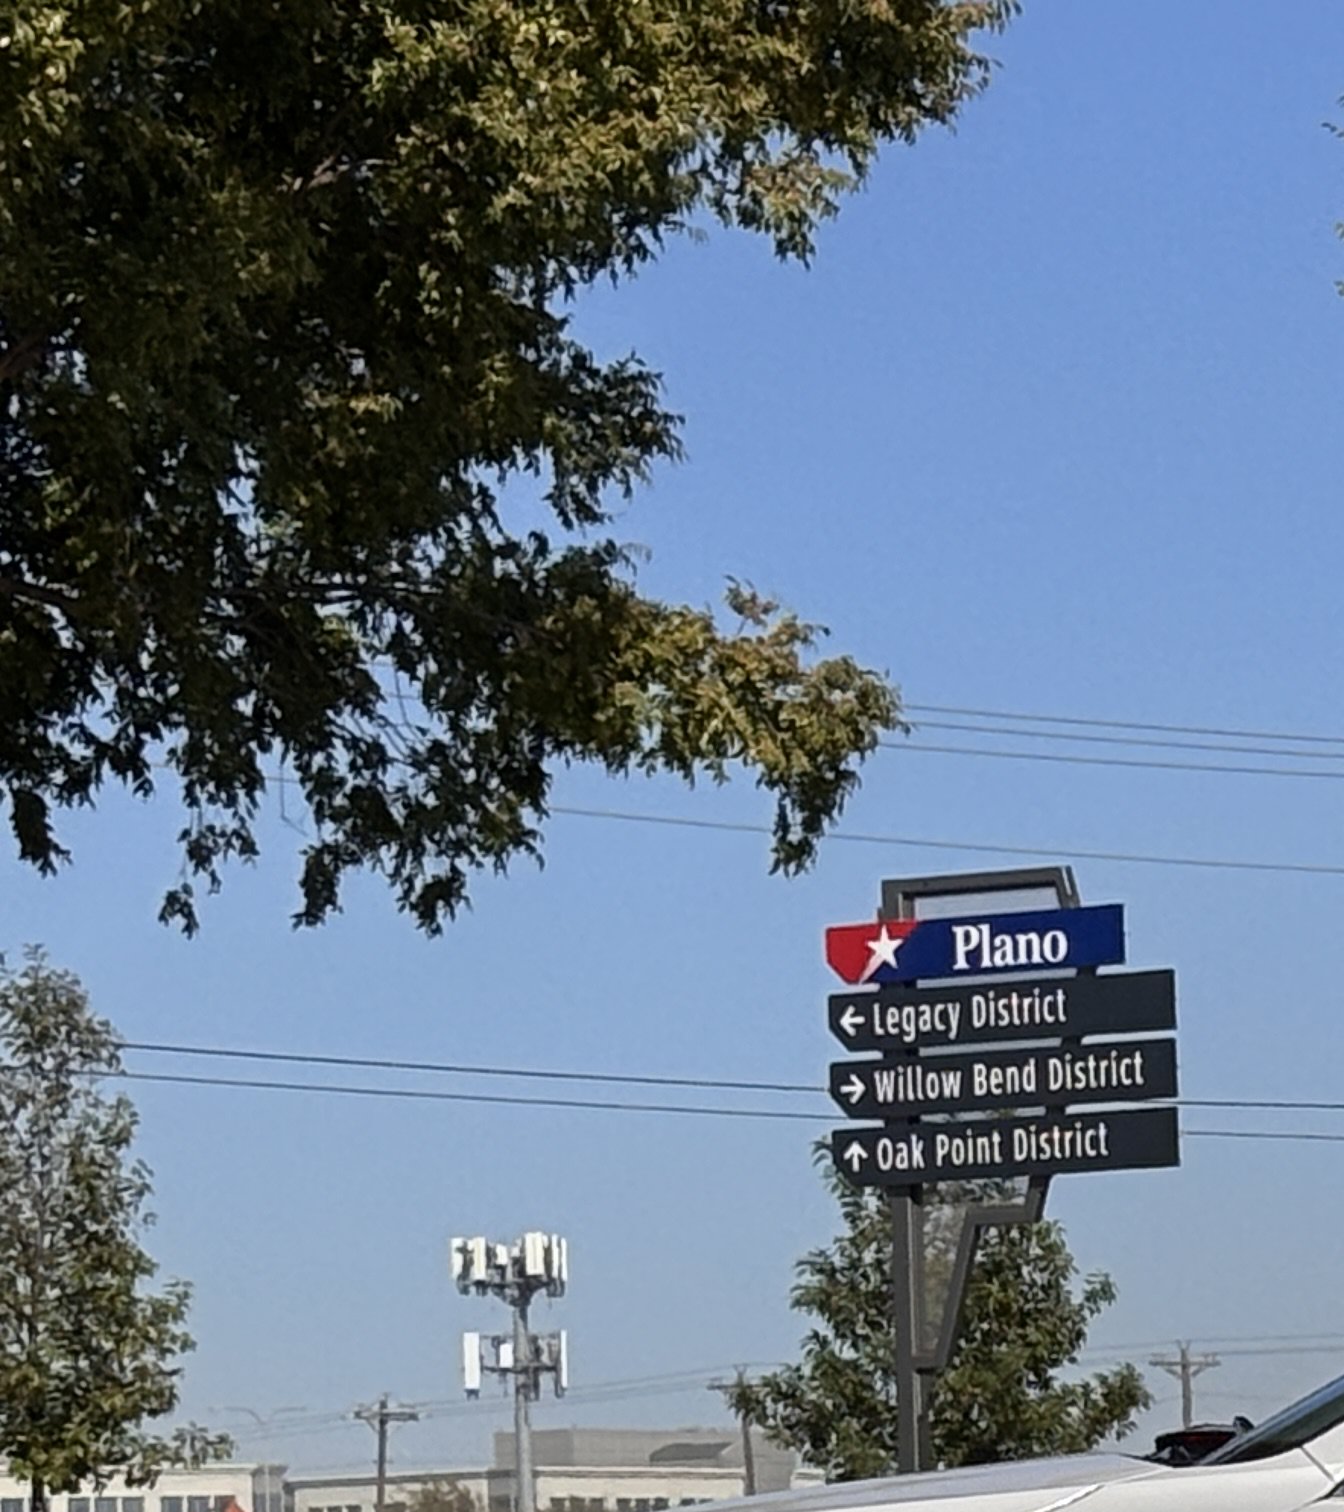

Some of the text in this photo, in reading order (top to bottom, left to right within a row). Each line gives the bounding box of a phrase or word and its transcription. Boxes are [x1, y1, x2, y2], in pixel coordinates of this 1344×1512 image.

[952, 924, 1068, 970] Plano
[873, 989, 1067, 1042] Legacy District
[874, 1050, 1145, 1103] Willow Bend District
[876, 1122, 1109, 1171] Oak Point District
